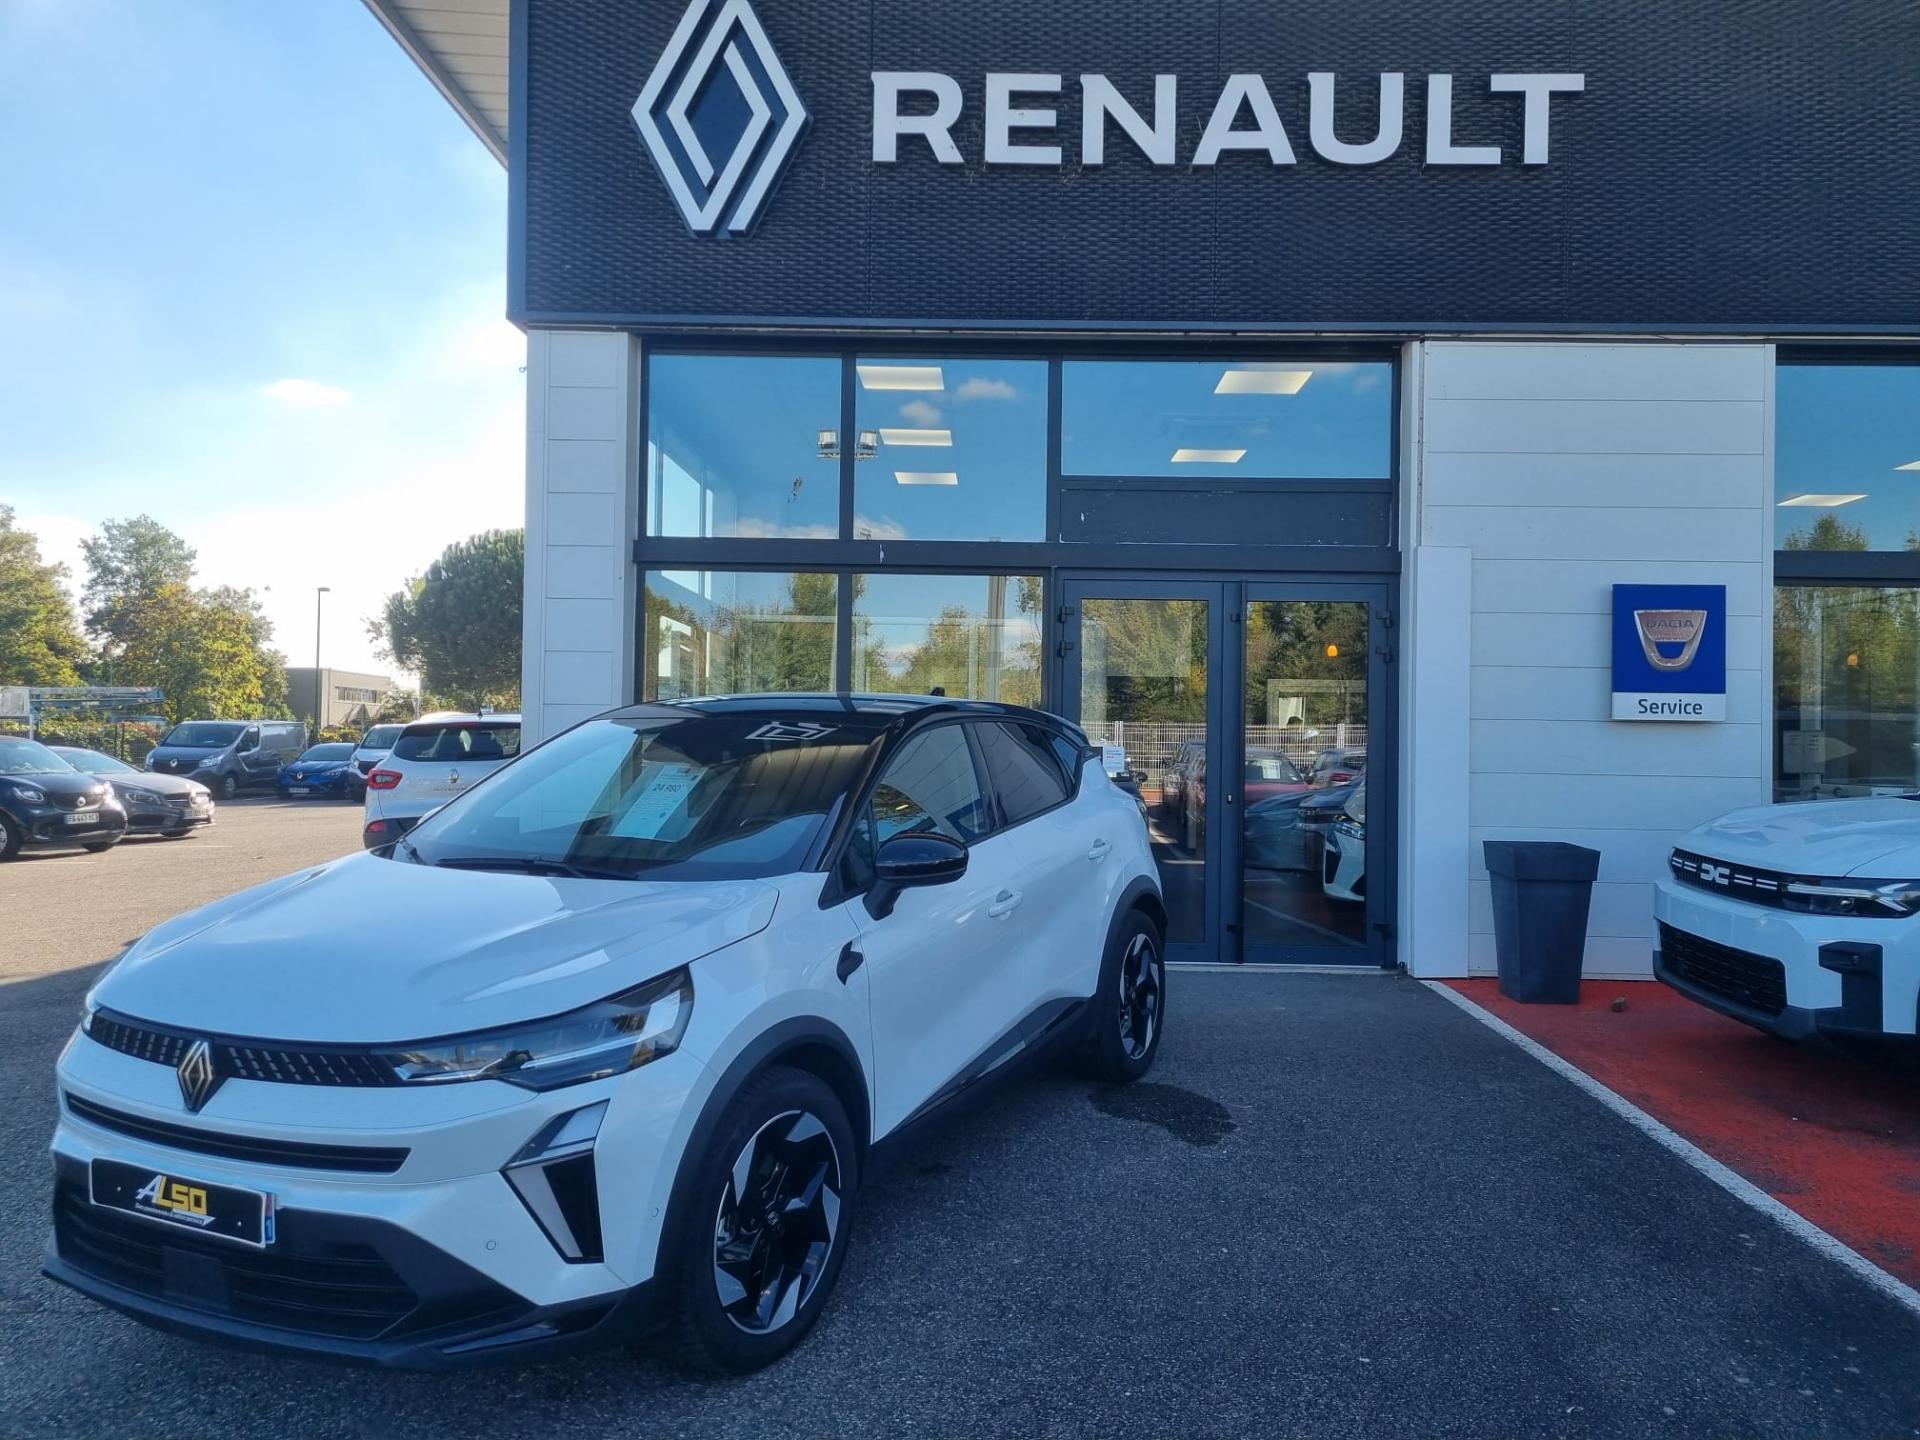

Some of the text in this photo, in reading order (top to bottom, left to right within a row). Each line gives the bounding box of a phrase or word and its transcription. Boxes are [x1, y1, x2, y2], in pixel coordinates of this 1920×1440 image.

[870, 71, 1585, 165] RENAULT
[1647, 619, 1695, 628] DACIA
[1638, 698, 1703, 715] Service
[135, 1175, 208, 1215] ALSO
